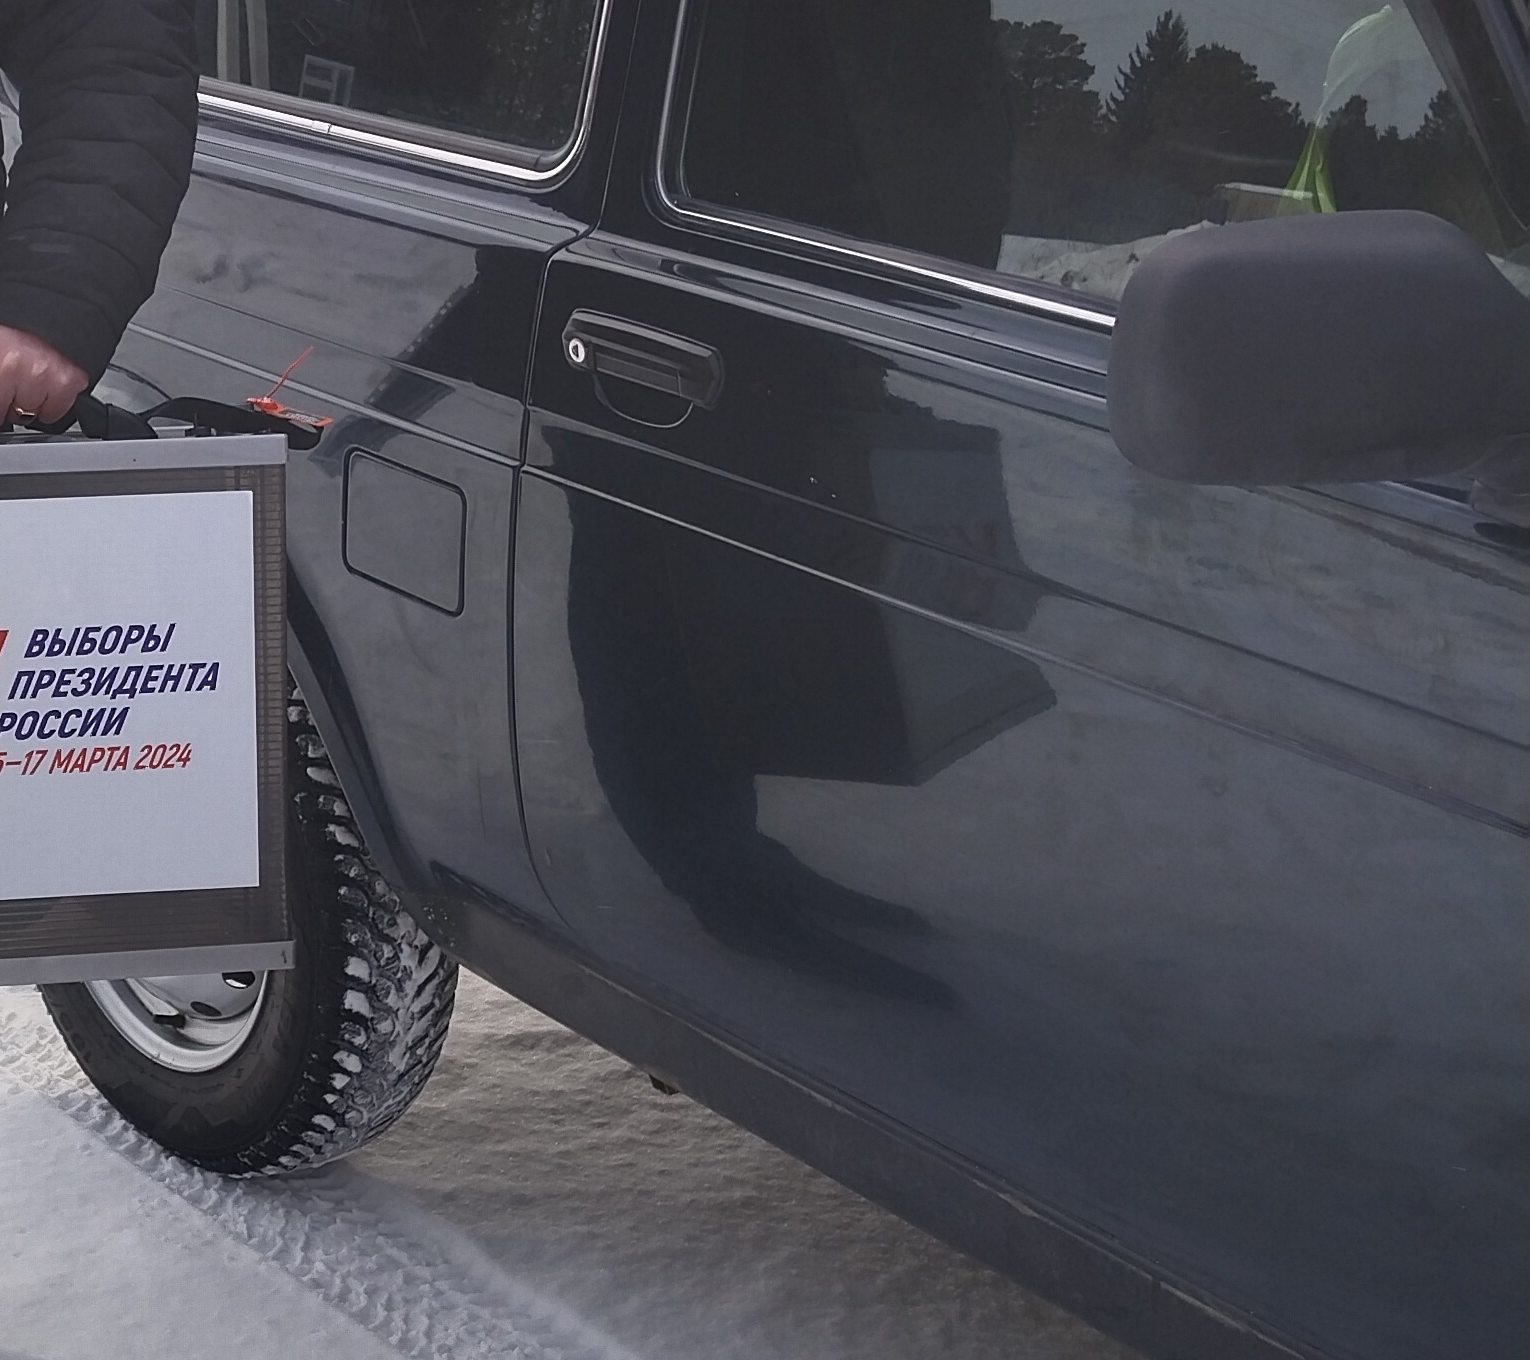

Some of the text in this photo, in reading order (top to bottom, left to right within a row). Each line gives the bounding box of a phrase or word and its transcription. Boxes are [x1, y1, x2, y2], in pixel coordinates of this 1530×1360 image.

[23, 623, 177, 659] ВЫБОРЫ
[7, 661, 221, 700] ПРЕЗИДЕНТА
[48, 745, 131, 774] МАРТА
[132, 742, 193, 771] 2024
